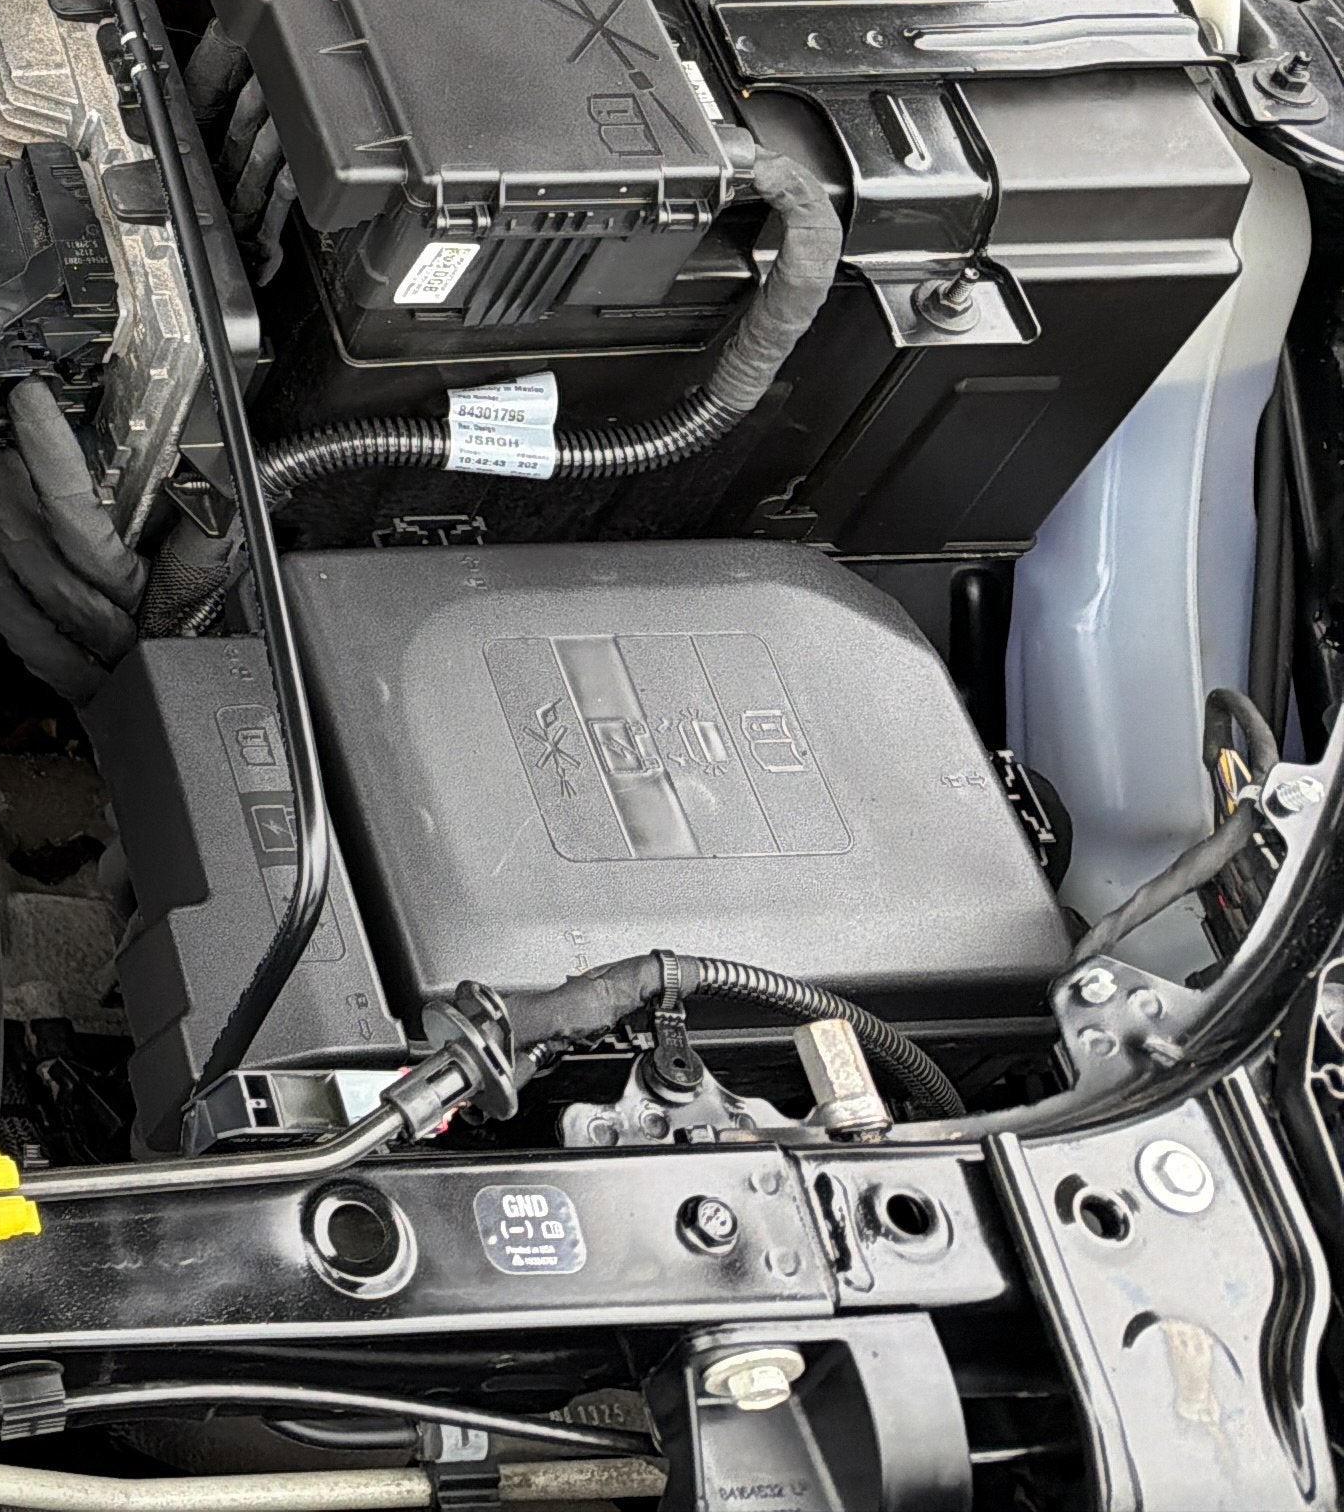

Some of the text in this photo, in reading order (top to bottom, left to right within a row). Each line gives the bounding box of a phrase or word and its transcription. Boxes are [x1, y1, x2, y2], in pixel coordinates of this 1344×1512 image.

[458, 404, 525, 423] 84301795
[459, 456, 506, 467] 10:42:43
[517, 461, 539, 469] 202
[502, 1194, 549, 1218] GND
